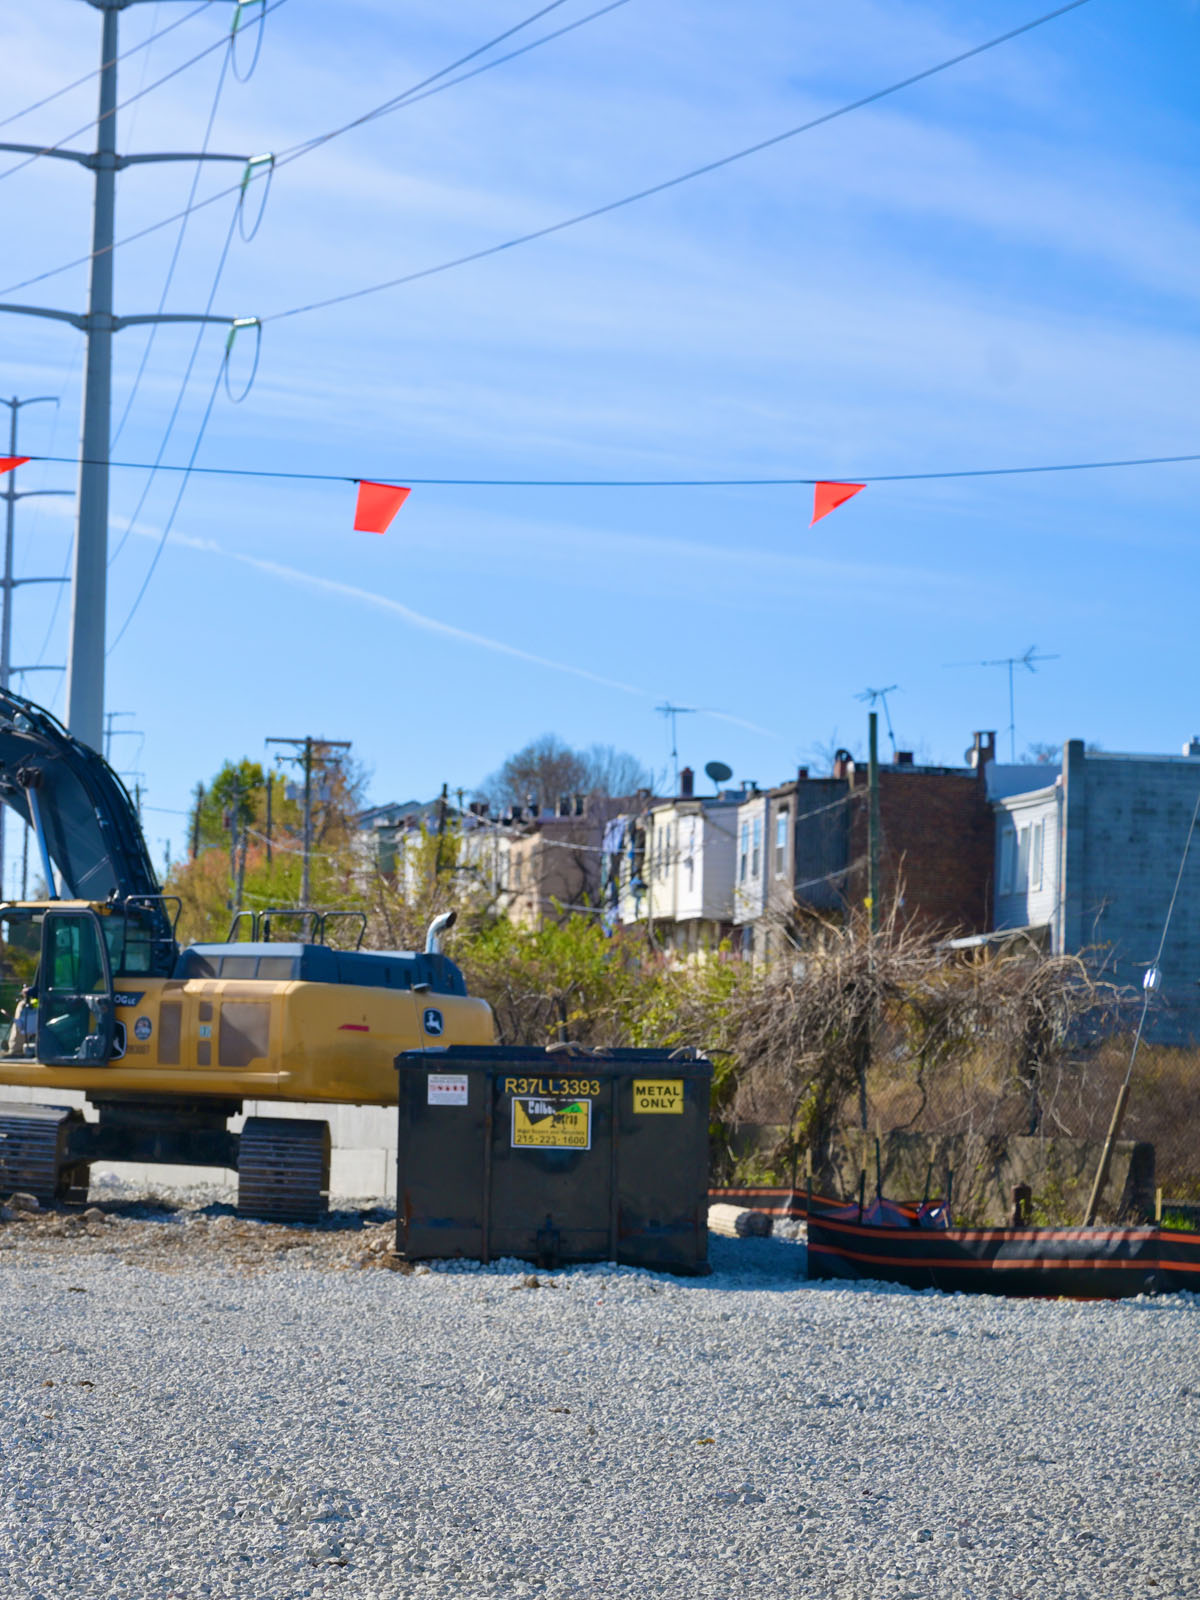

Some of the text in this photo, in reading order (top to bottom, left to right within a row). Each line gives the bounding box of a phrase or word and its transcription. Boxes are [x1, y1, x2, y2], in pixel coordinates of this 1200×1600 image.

[504, 1078, 601, 1096] R37LL3393
[636, 1086, 681, 1096] METAL
[640, 1098, 676, 1108] ONLY
